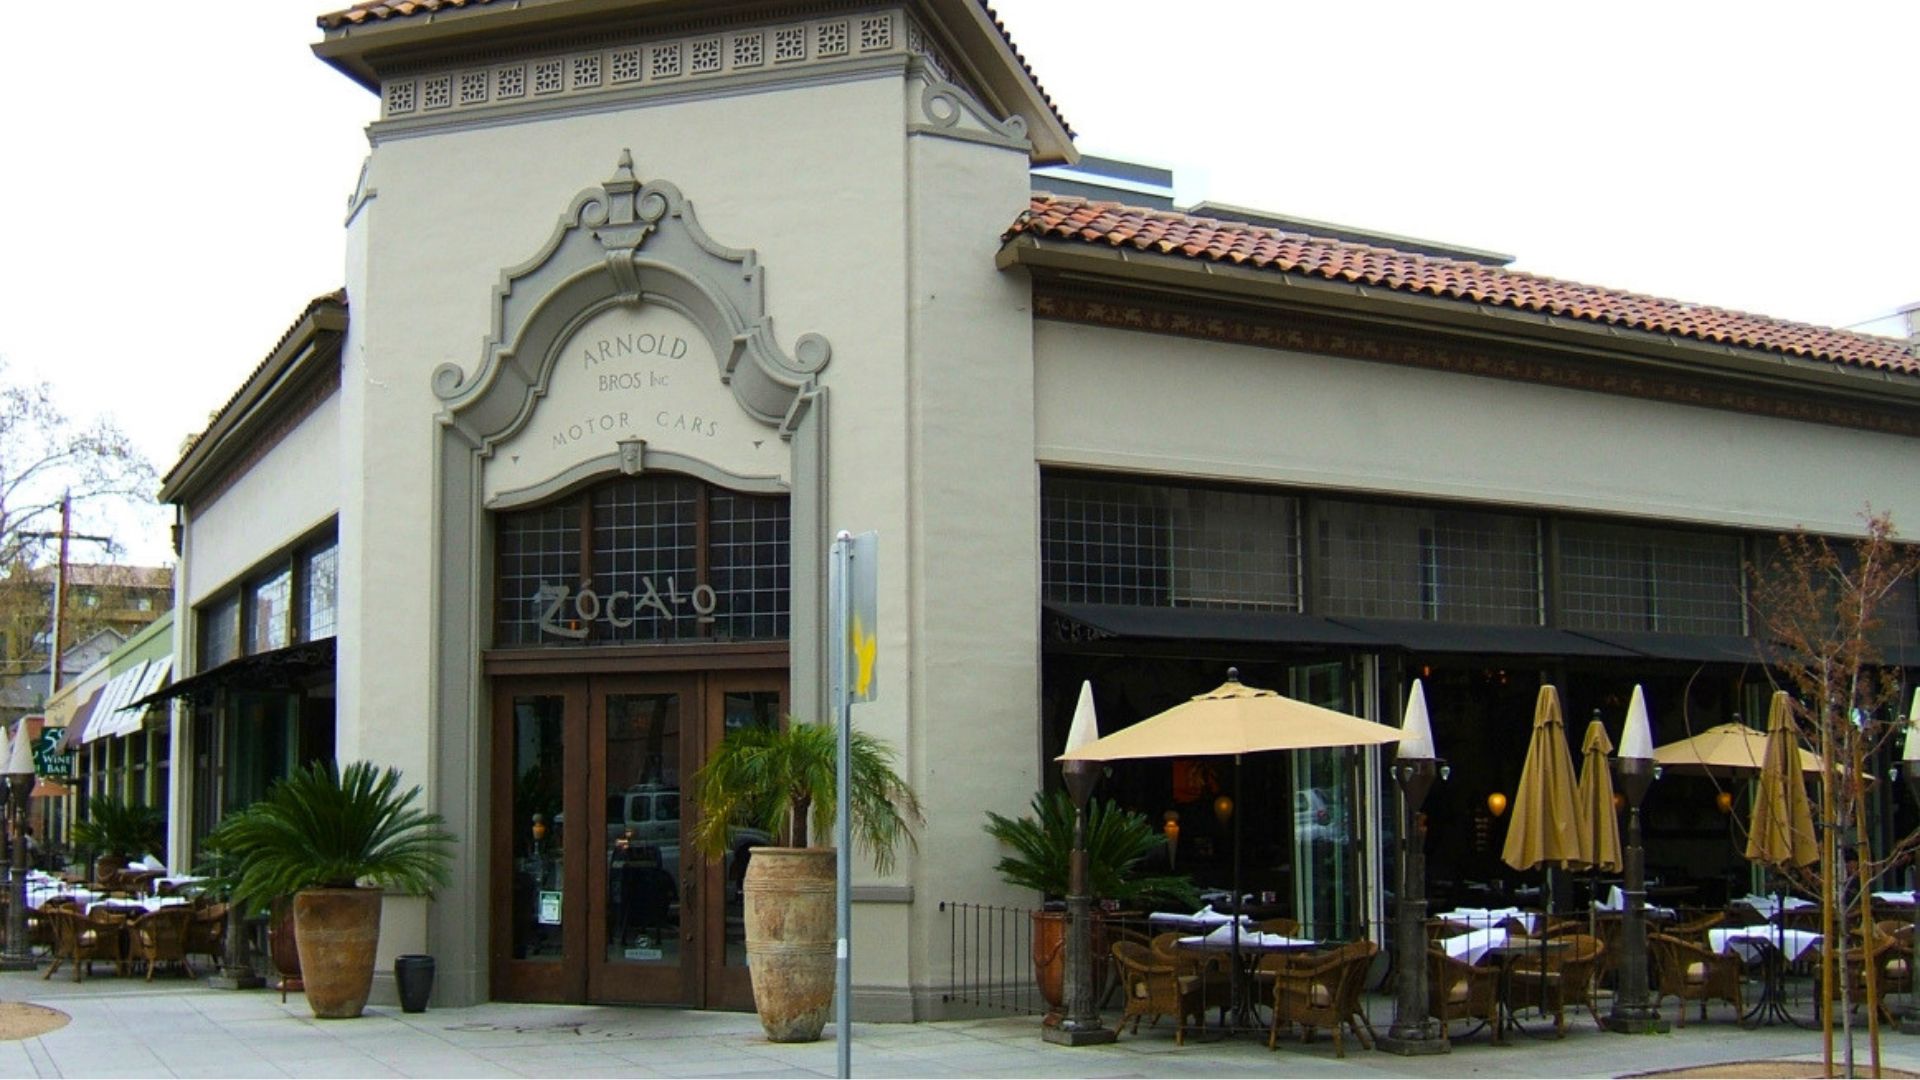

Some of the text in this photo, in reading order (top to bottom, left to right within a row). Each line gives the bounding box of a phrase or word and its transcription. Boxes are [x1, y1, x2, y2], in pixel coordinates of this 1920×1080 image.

[583, 333, 687, 369] ARNOLD
[599, 373, 641, 391] BROS
[553, 411, 718, 448] MOTOR CARS
[43, 755, 71, 764] WINE
[47, 764, 68, 774] BAR
